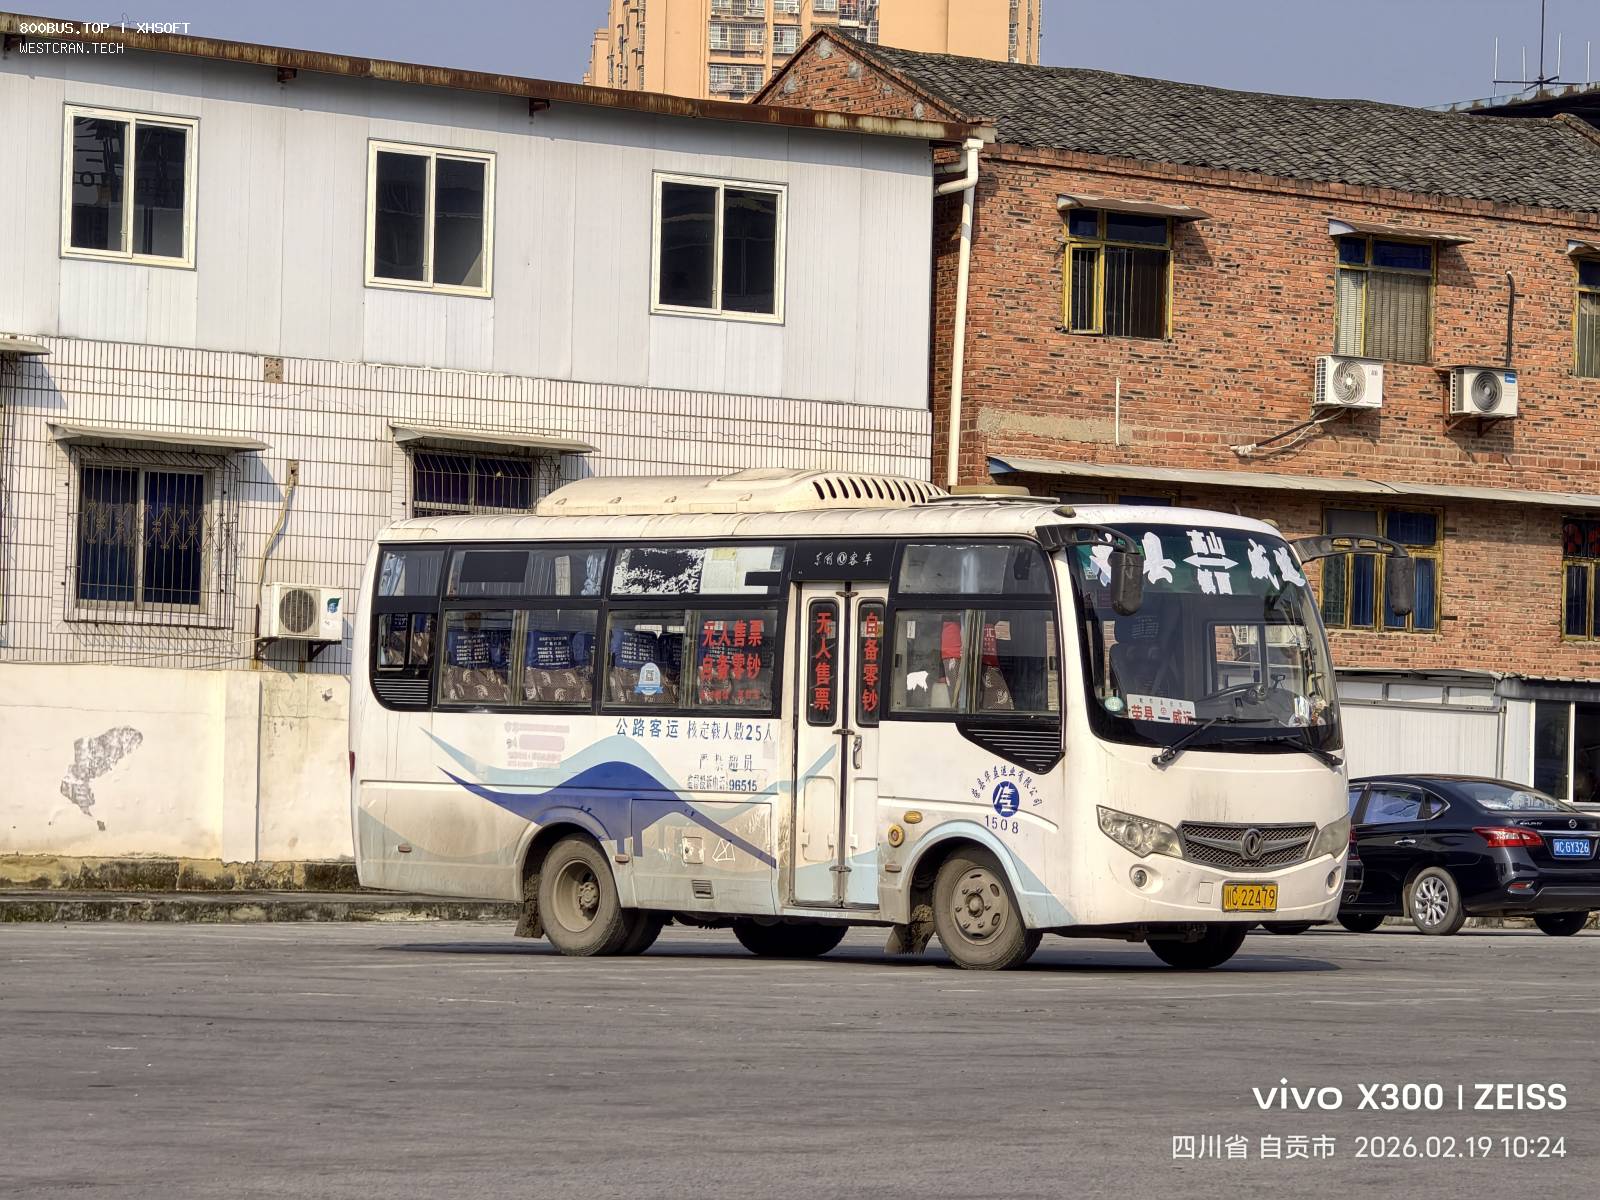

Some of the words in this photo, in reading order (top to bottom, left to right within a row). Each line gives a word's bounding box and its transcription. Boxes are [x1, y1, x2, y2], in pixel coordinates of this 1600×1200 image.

[702, 618, 764, 647] 无人售票
[702, 653, 762, 681] 自备零钞
[815, 612, 832, 711] 无人售票
[862, 611, 879, 712] 自备零钞
[616, 717, 679, 738] 公路客运
[687, 720, 773, 742] 核定载人数25人
[985, 814, 1020, 835] 1508
